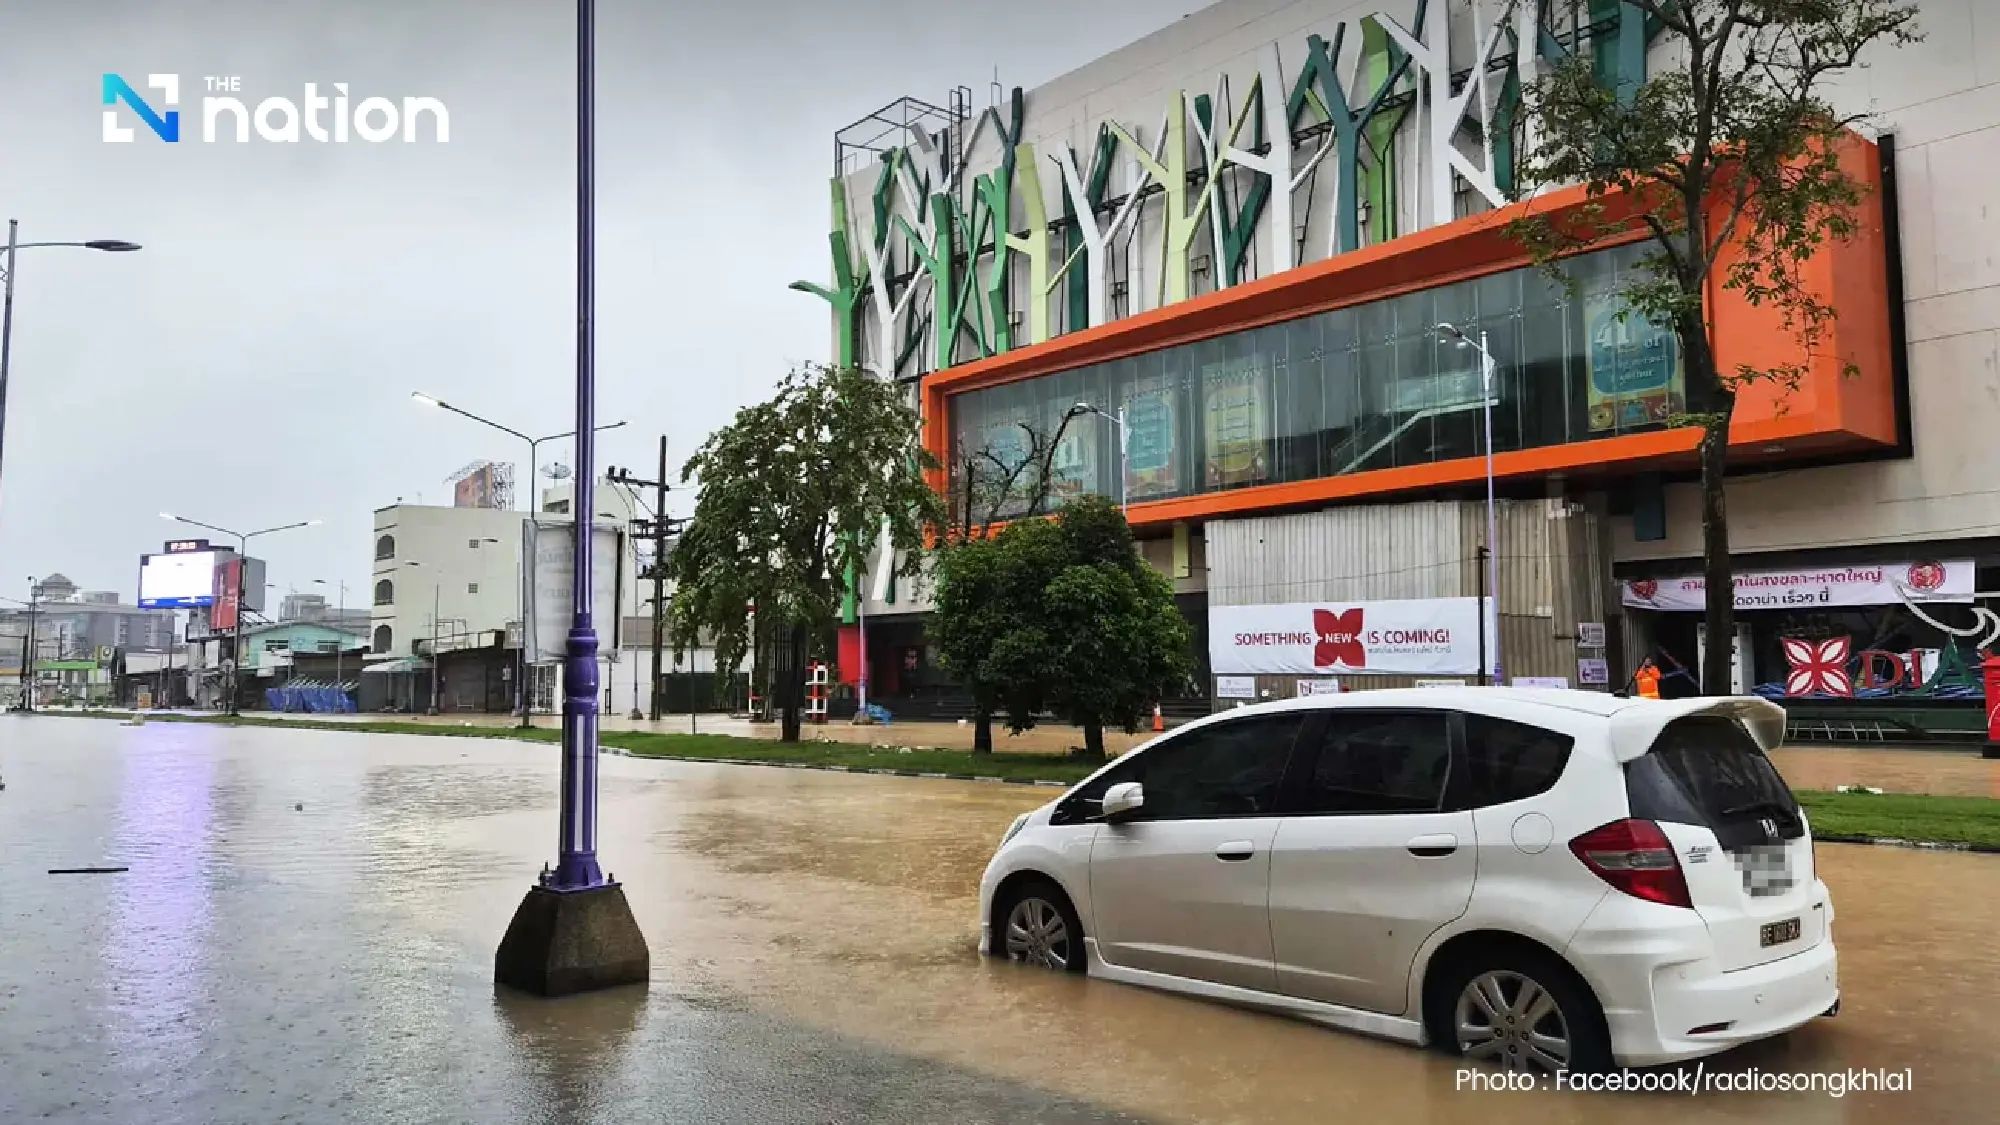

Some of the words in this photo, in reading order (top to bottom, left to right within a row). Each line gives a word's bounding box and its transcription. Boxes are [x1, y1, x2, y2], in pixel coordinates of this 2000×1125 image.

[1234, 632, 1312, 646] SOMETHING
[1324, 632, 1353, 644] NEW
[1367, 630, 1380, 644] IS
[1384, 628, 1451, 644] COMING!
